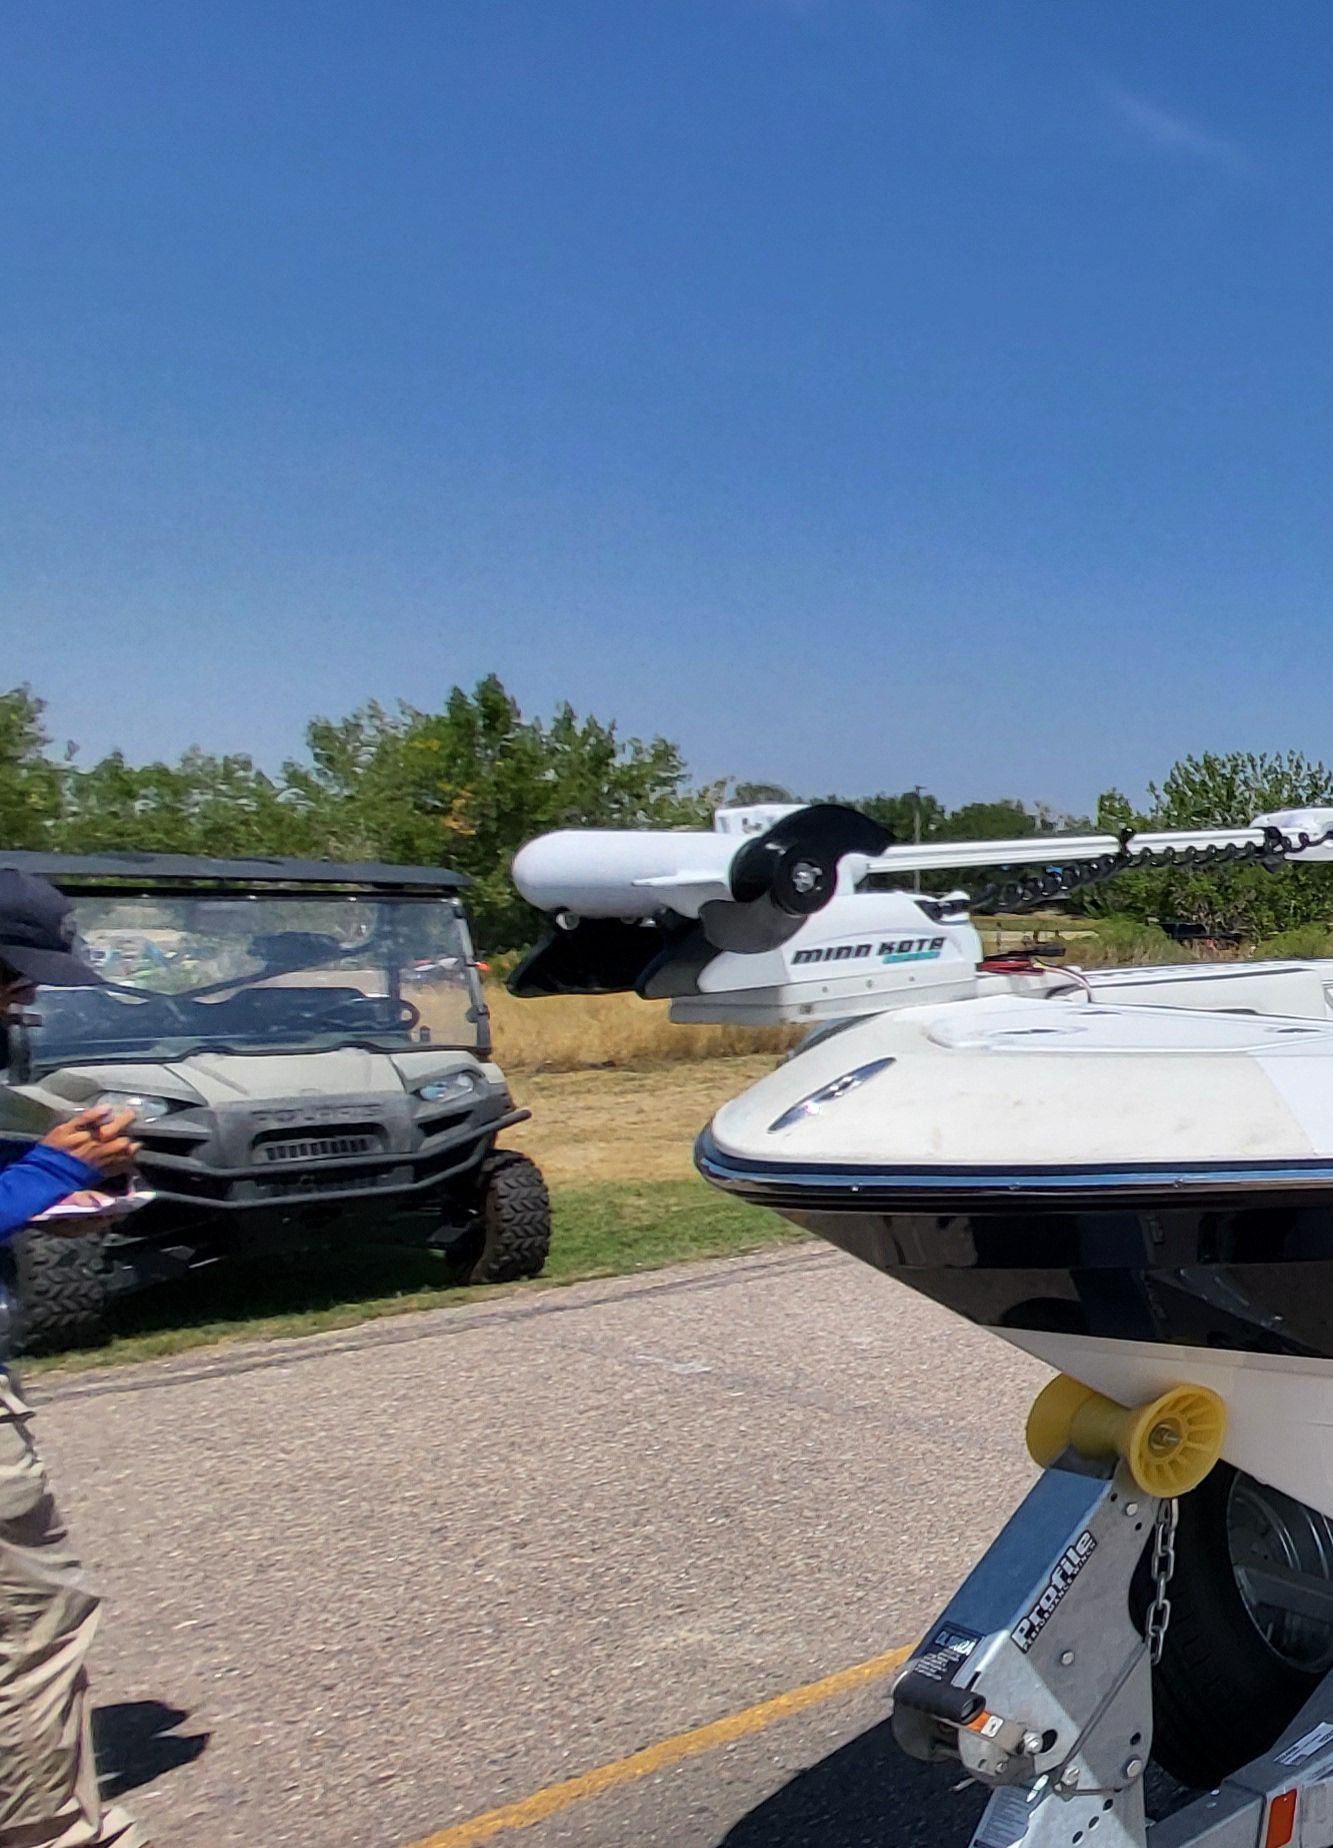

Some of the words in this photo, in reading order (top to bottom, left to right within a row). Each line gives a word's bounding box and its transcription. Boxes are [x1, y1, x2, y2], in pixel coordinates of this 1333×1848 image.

[790, 943, 873, 965] MINN
[875, 937, 948, 956] KOTA
[1011, 1530, 1094, 1649] Profile
